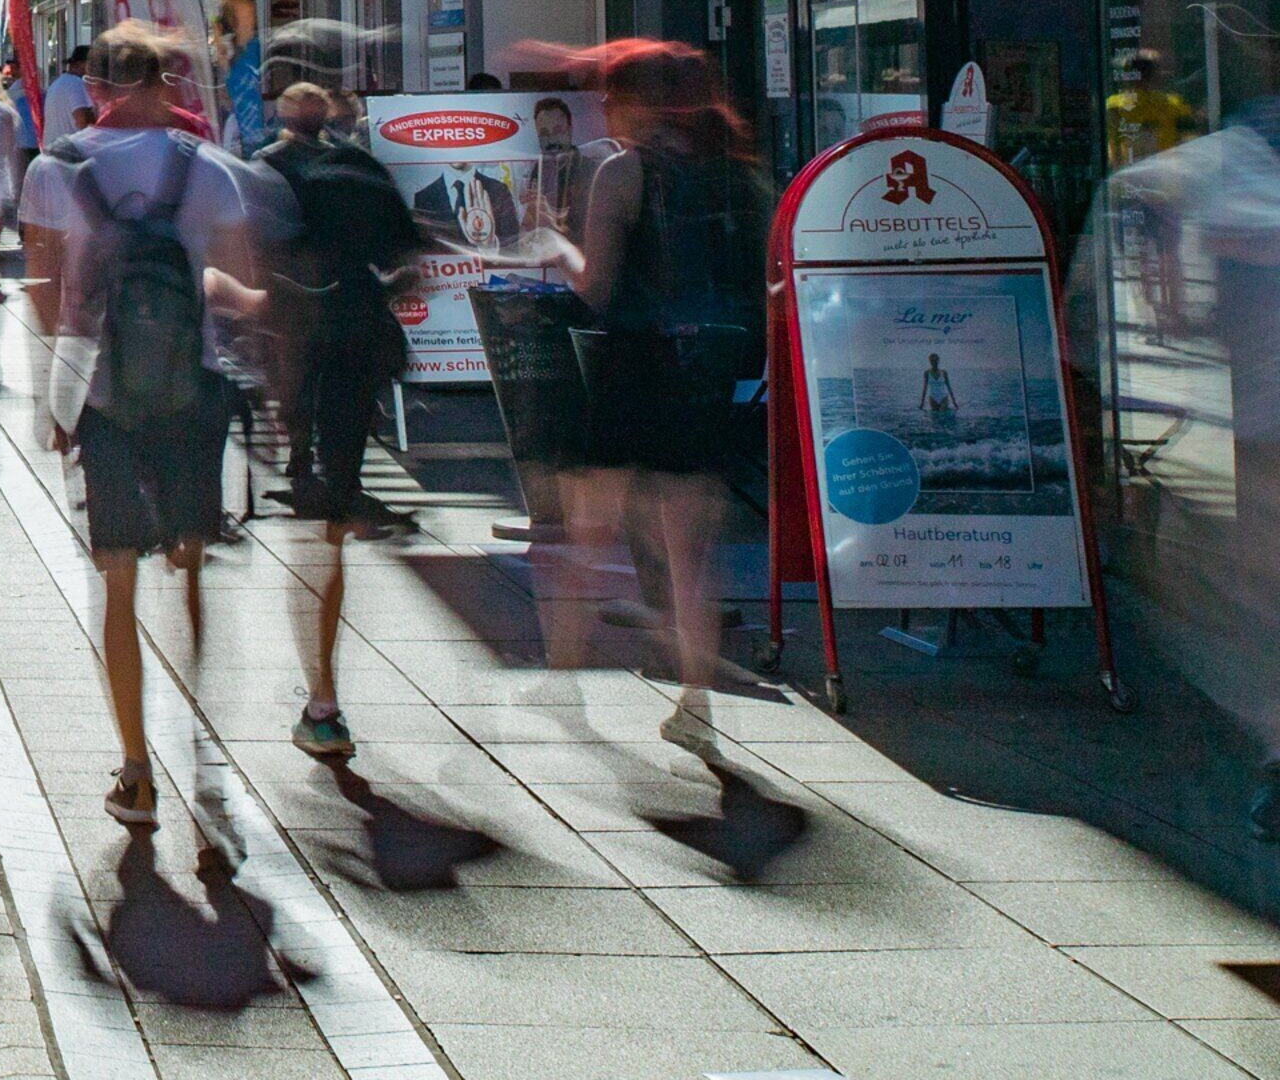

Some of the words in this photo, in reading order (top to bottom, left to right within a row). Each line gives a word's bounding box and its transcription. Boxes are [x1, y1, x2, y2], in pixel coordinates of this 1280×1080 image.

[388, 115, 510, 133] ÄNDERUNGSSCHNEIDEREI
[412, 127, 486, 142] EXPRESS
[421, 255, 482, 280] tion!
[411, 336, 454, 346] Minuten
[842, 454, 876, 468] Gehen
[880, 475, 914, 490] Grund
[893, 527, 1013, 545] Hautberatung
